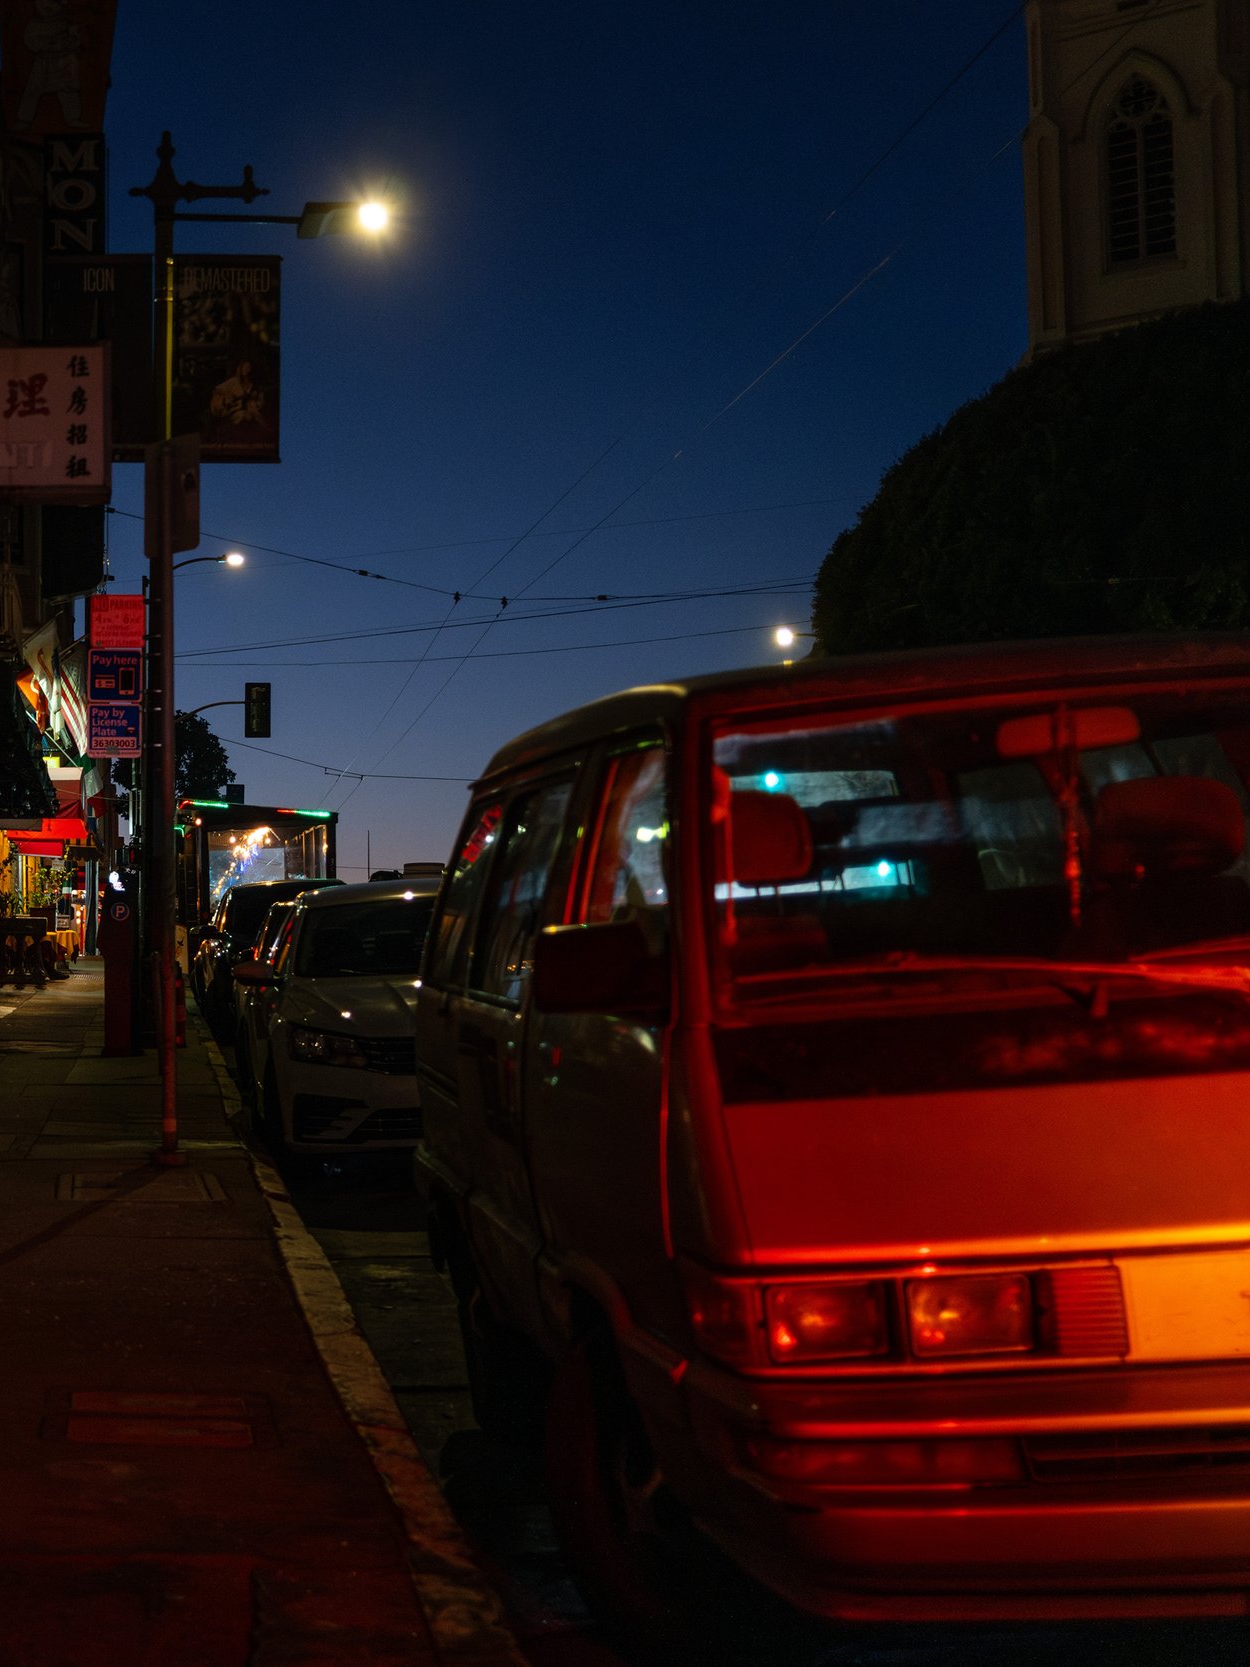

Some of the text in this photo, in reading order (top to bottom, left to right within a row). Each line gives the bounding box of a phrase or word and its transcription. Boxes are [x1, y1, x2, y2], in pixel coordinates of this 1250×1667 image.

[83, 267, 114, 292] ICON
[184, 267, 270, 293] REMASTERED
[92, 655, 138, 668] Pay here
[92, 708, 126, 719] Pay by
[92, 718, 128, 727] License
[92, 727, 117, 737] Plate
